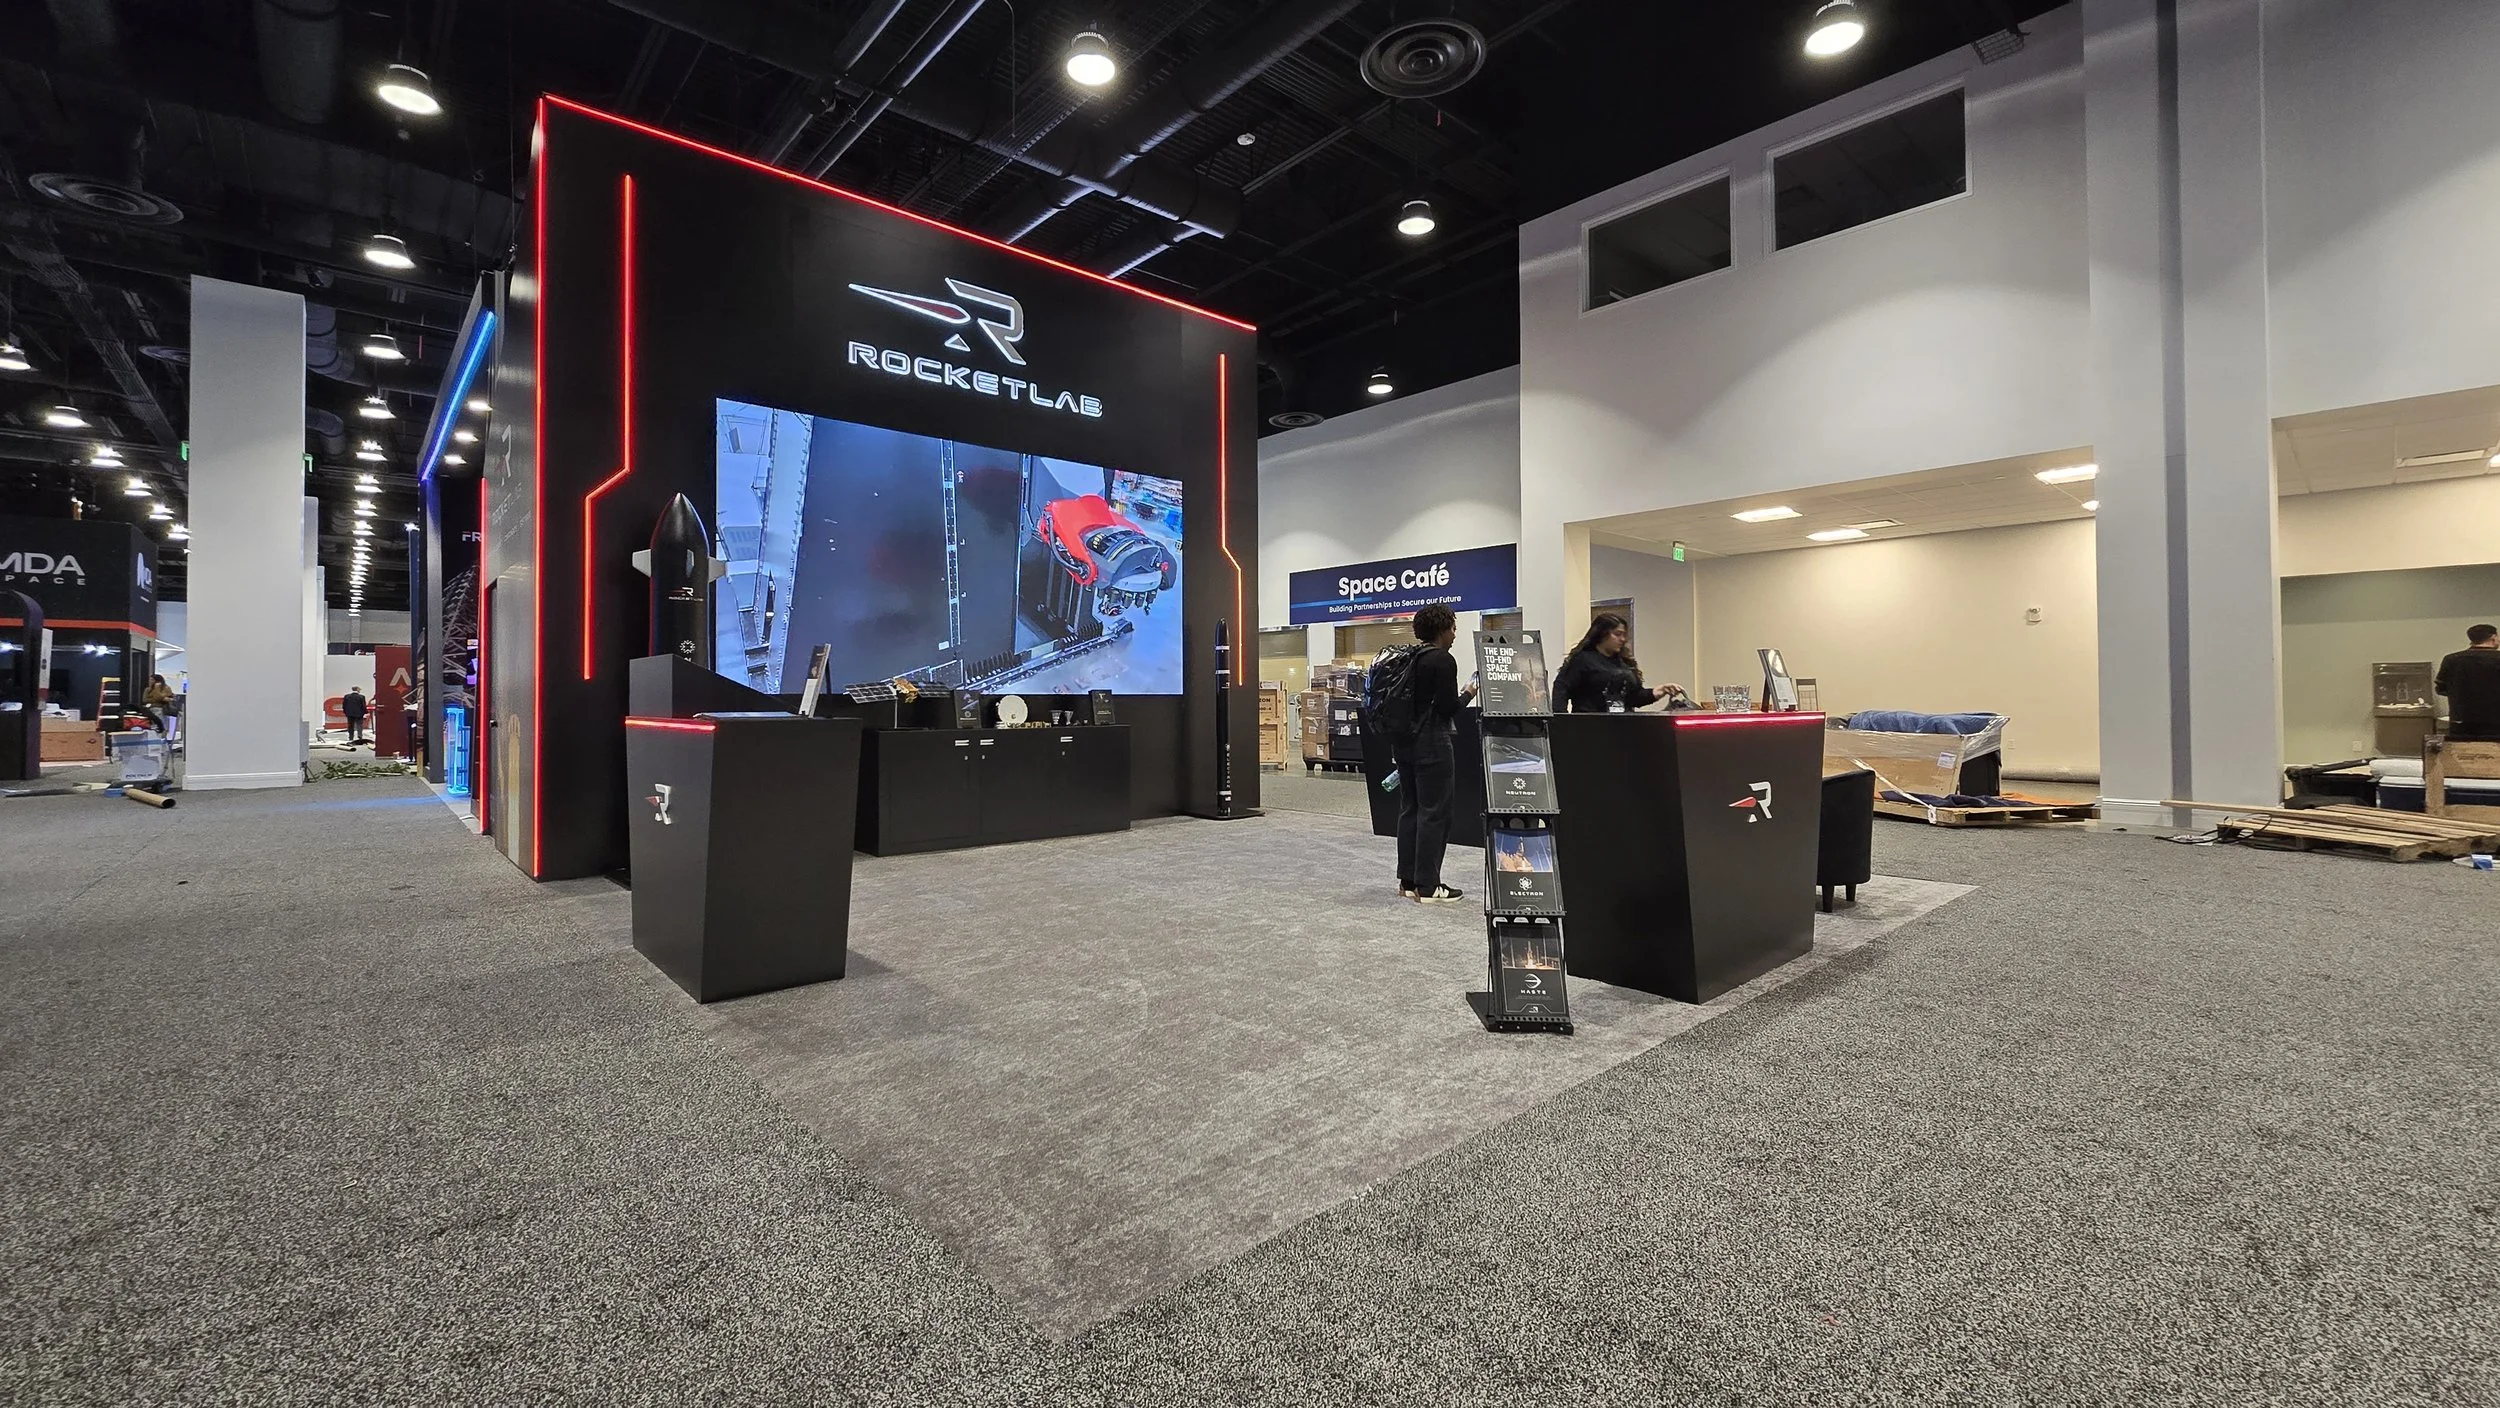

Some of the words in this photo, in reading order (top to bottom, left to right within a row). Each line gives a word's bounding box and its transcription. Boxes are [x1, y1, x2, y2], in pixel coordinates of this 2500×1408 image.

[848, 340, 1103, 418] ROCKETLAB
[461, 531, 482, 542] FR
[0, 552, 85, 576] MDA
[4, 574, 87, 586] PACE
[1338, 577, 1397, 601] Space
[1400, 562, 1450, 590] Café
[1329, 604, 1353, 614] Building
[1353, 600, 1393, 612] Partnerships
[1393, 600, 1400, 608] to
[1401, 598, 1425, 607] Secure
[1425, 597, 1438, 605] our
[1439, 595, 1462, 604] Future
[1484, 647, 1498, 656] THE
[1499, 647, 1518, 657] END-
[1484, 655, 1512, 665] TO-END
[1486, 664, 1510, 673] SPACE
[1487, 672, 1522, 682] COMPANY
